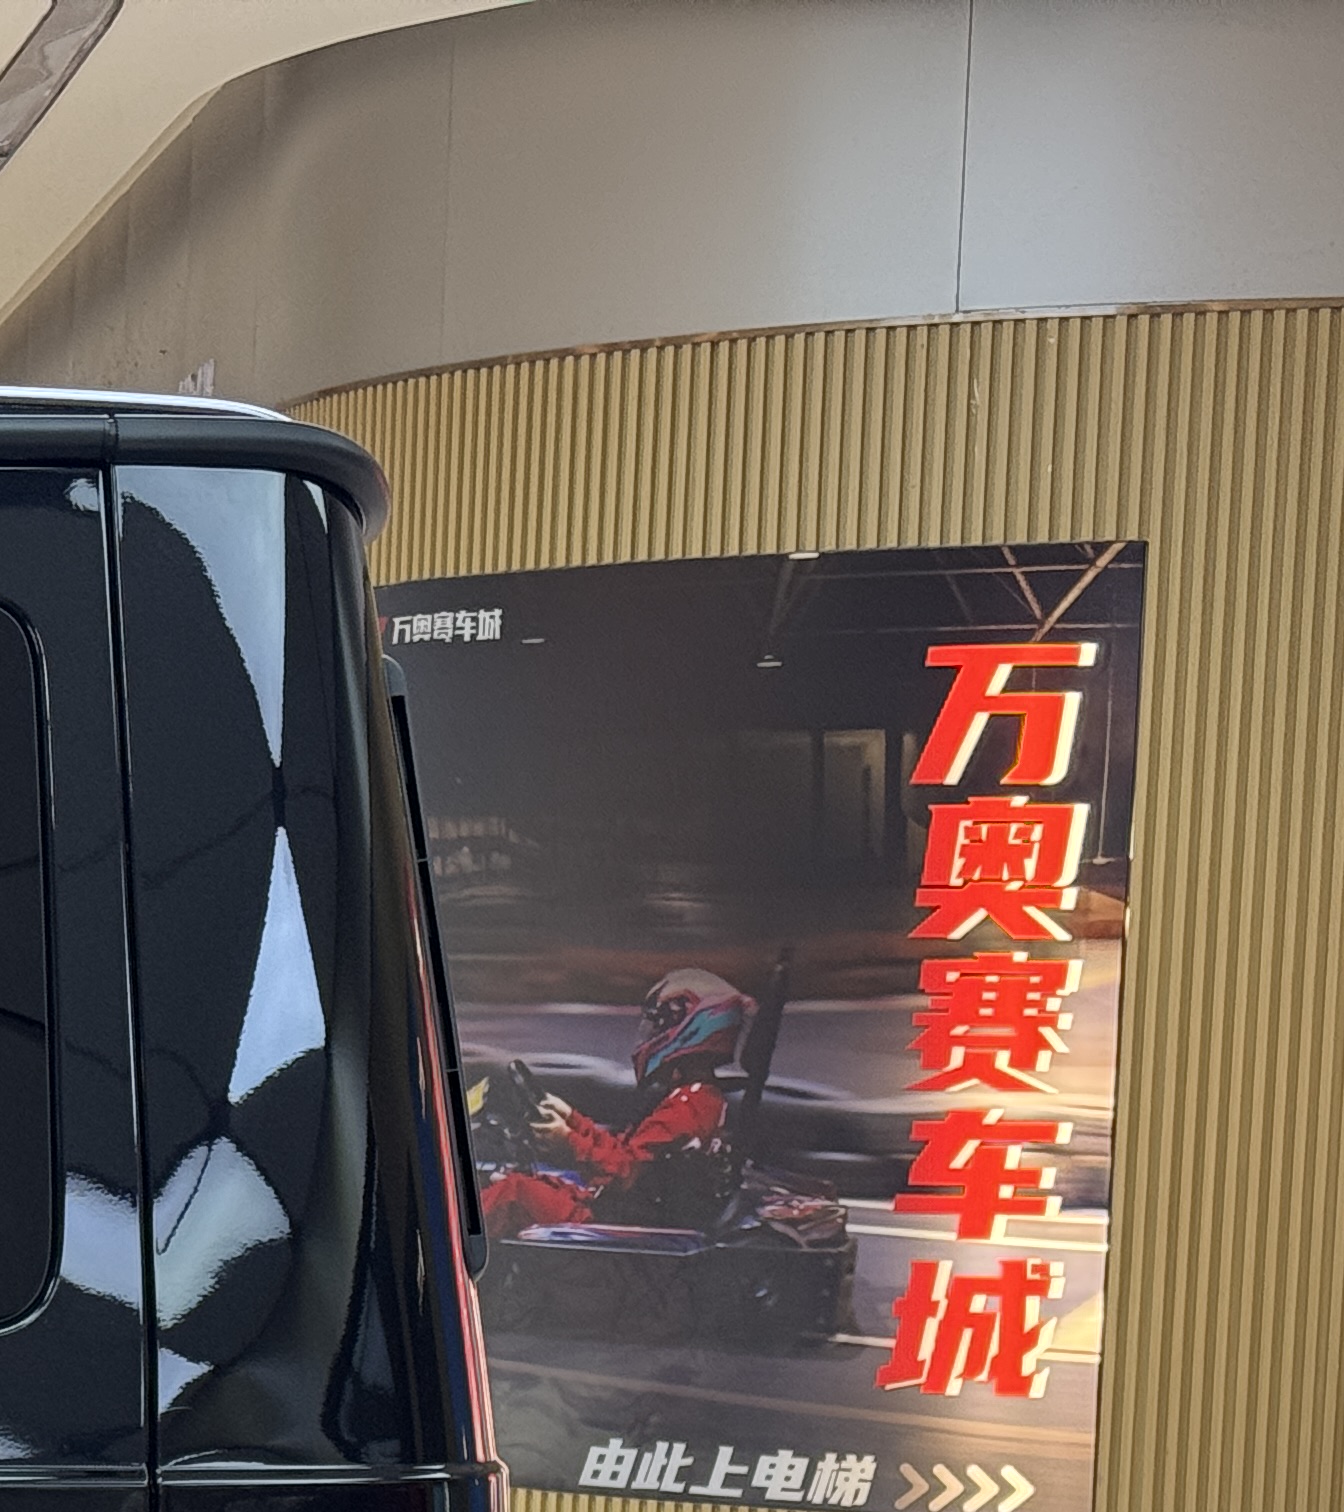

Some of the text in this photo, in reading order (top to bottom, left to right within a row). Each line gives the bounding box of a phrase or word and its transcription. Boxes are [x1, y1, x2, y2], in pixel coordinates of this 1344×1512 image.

[392, 609, 502, 644] 万奥赛车城
[874, 641, 1099, 1399] 万奥赛车城
[577, 1438, 879, 1506] 由此上电梯
